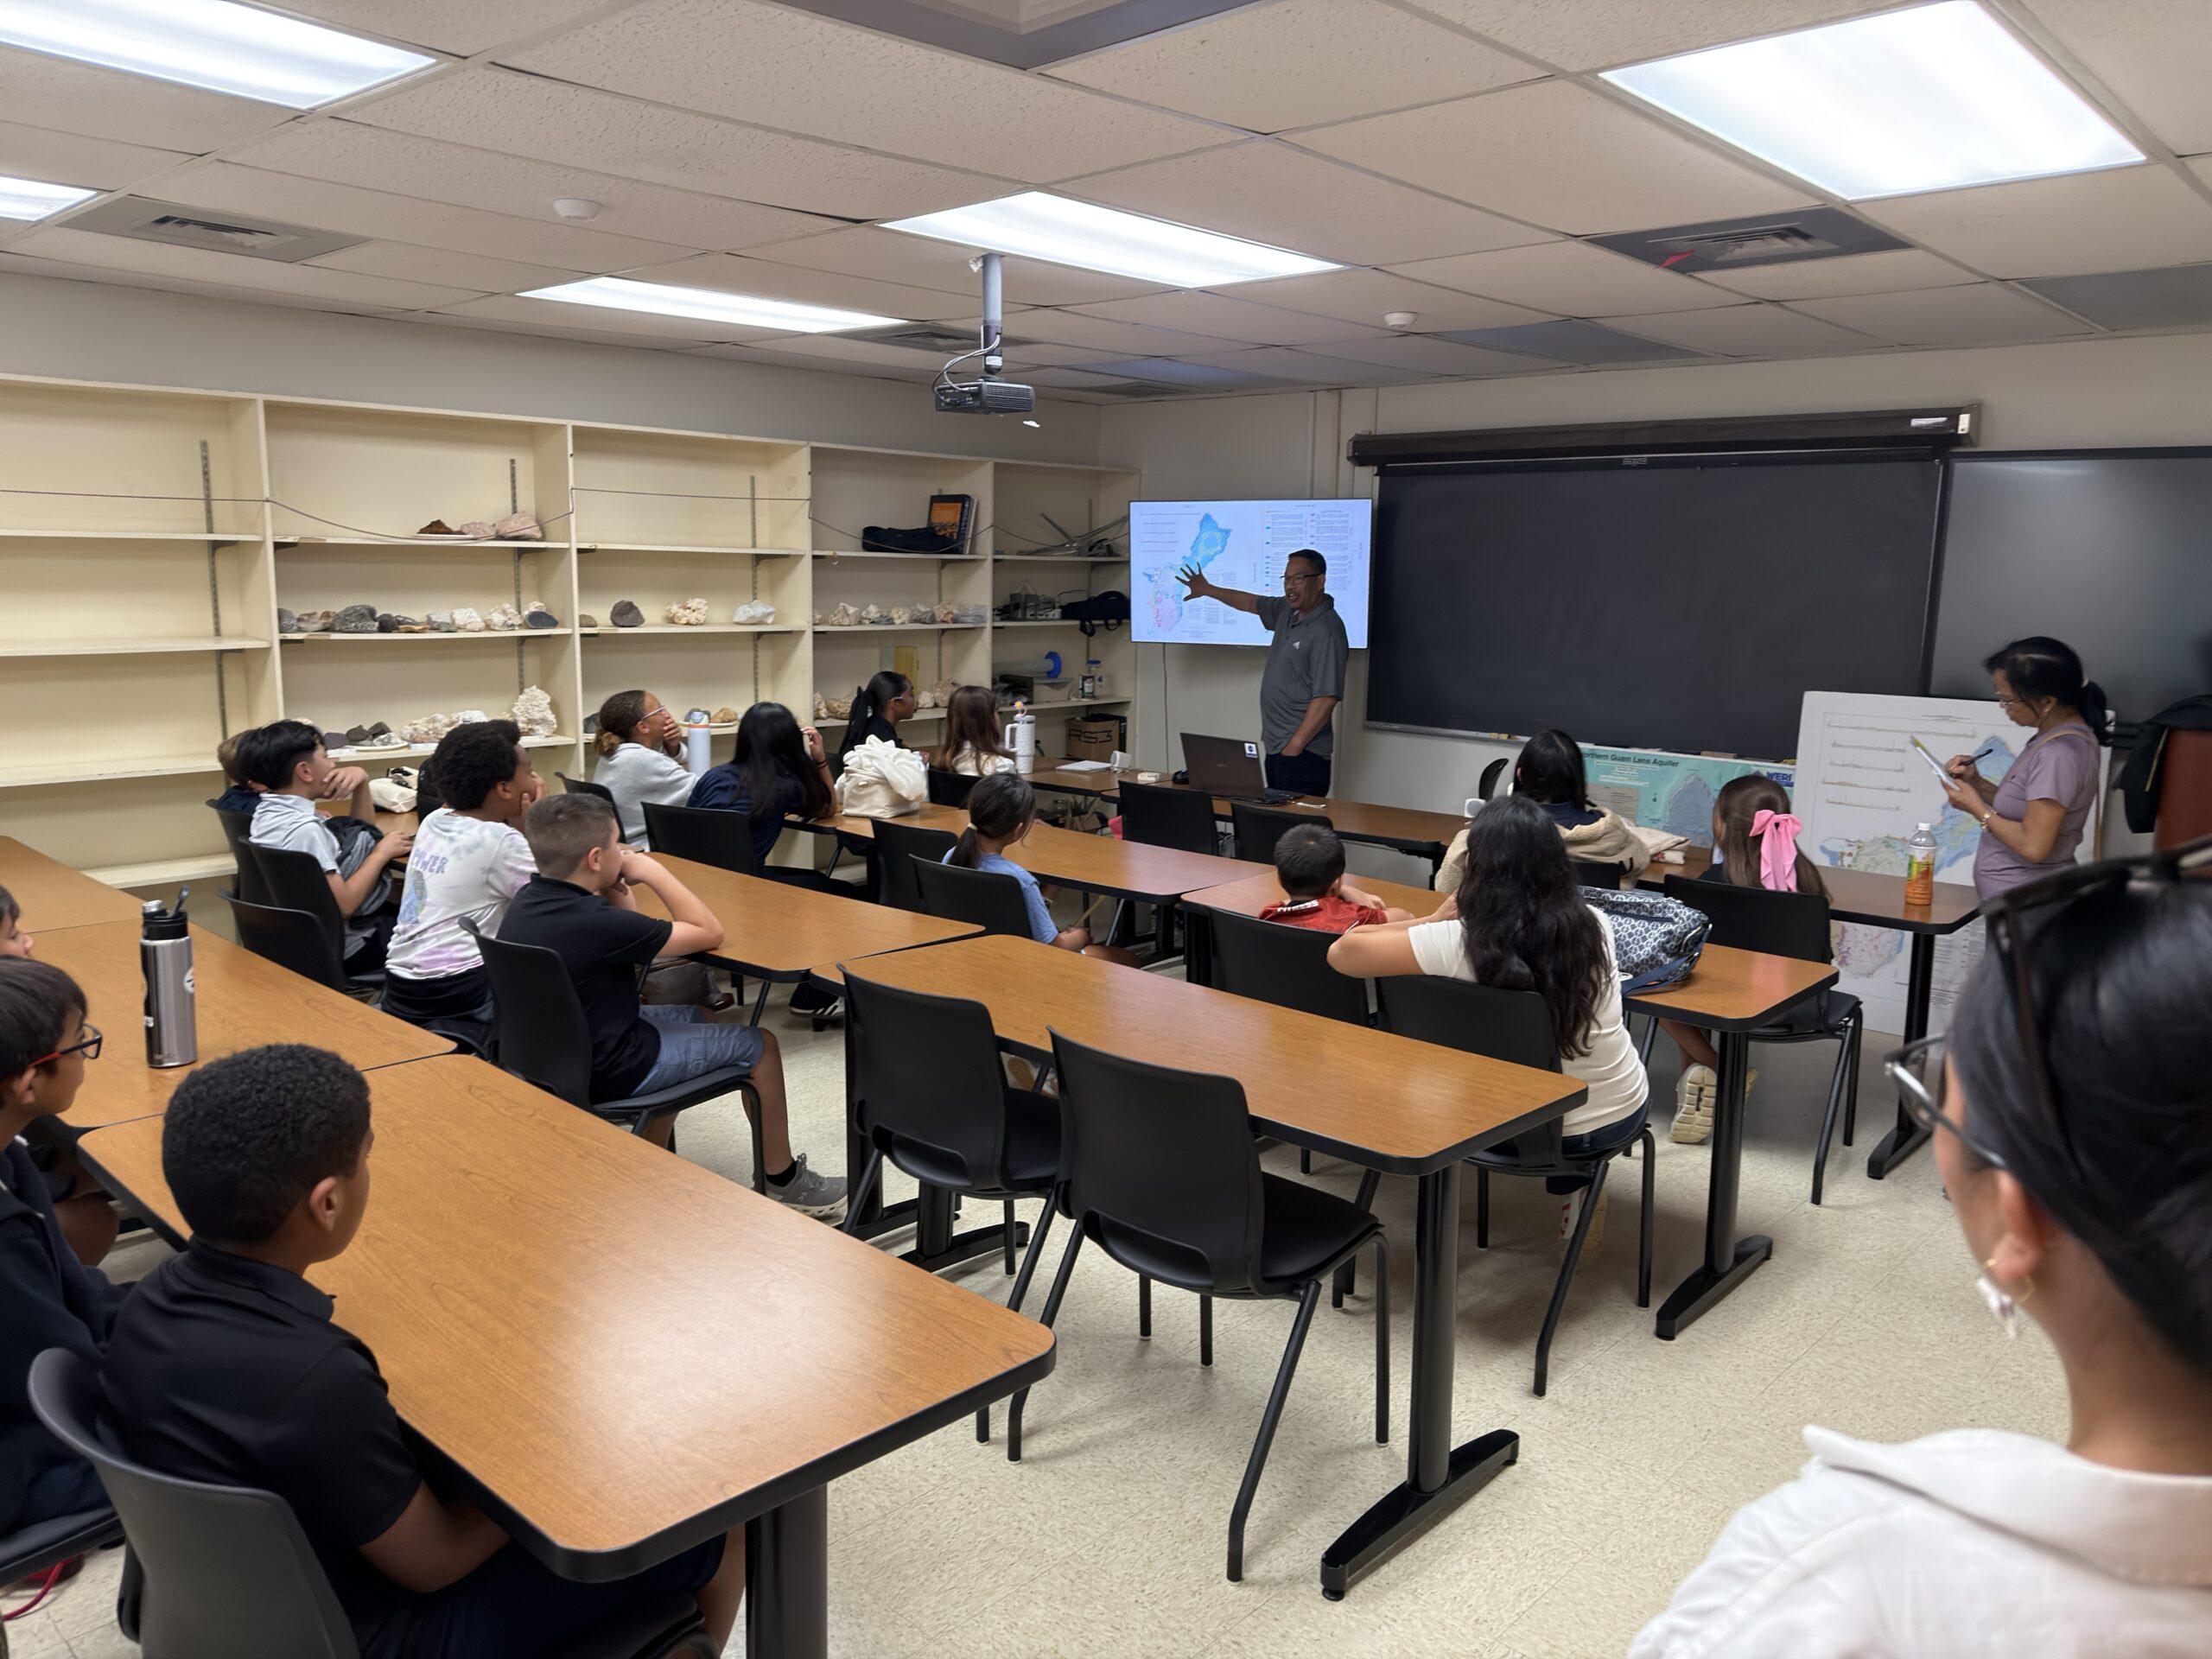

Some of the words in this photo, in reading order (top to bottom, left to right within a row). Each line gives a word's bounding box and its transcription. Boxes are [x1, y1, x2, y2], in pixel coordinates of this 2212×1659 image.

[1582, 751, 1609, 761] orthern
[1611, 753, 1632, 762] Guam
[1633, 756, 1651, 765] Lens
[1651, 758, 1680, 767] Aquifer
